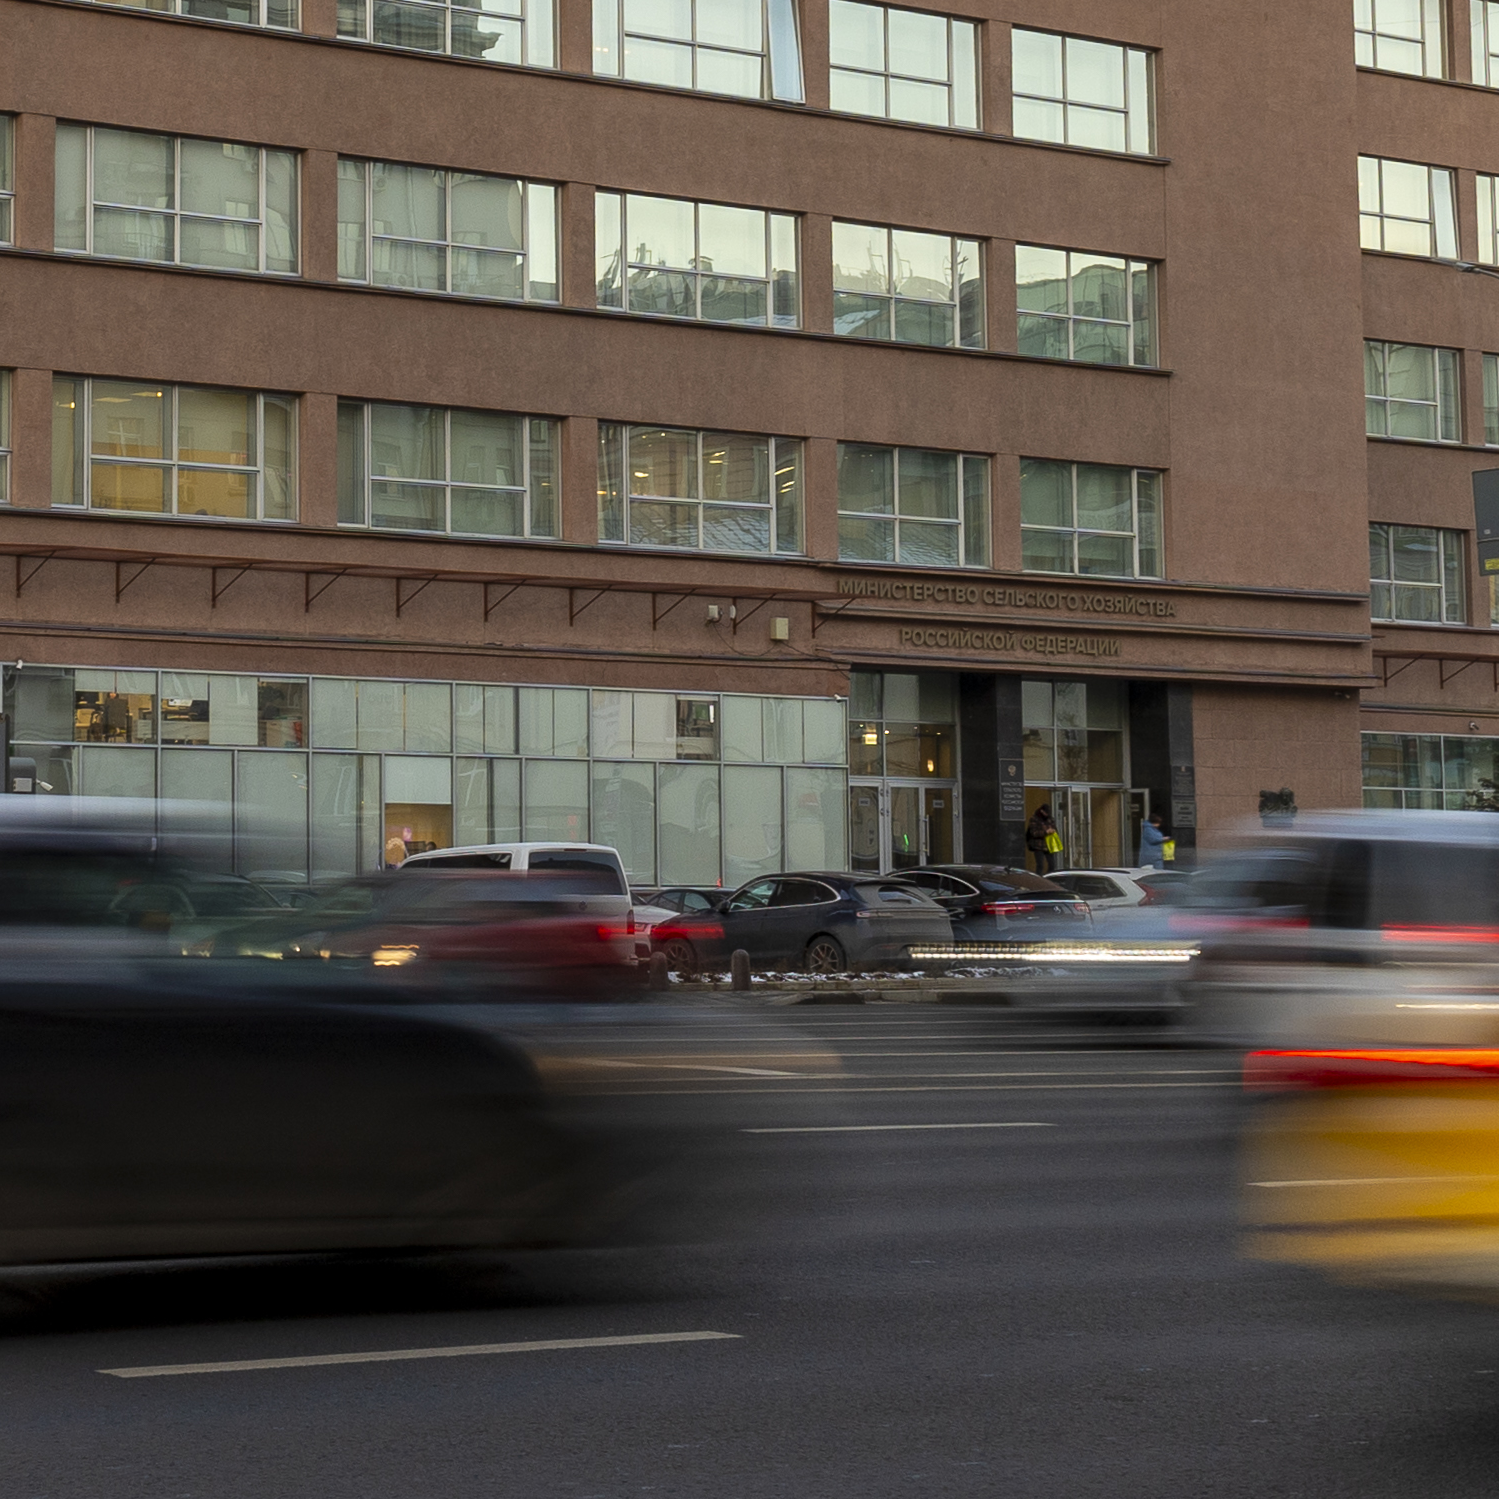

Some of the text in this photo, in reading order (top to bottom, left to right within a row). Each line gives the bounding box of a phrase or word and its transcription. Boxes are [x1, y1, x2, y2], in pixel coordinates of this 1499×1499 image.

[837, 578, 1176, 617] МИНИСТЕРСТВО СЕЛЬСКОГО ХОЗЯЙСТВА
[901, 628, 1121, 657] РОССИЙСКОЙ ФЕДЕРАЦИИ
